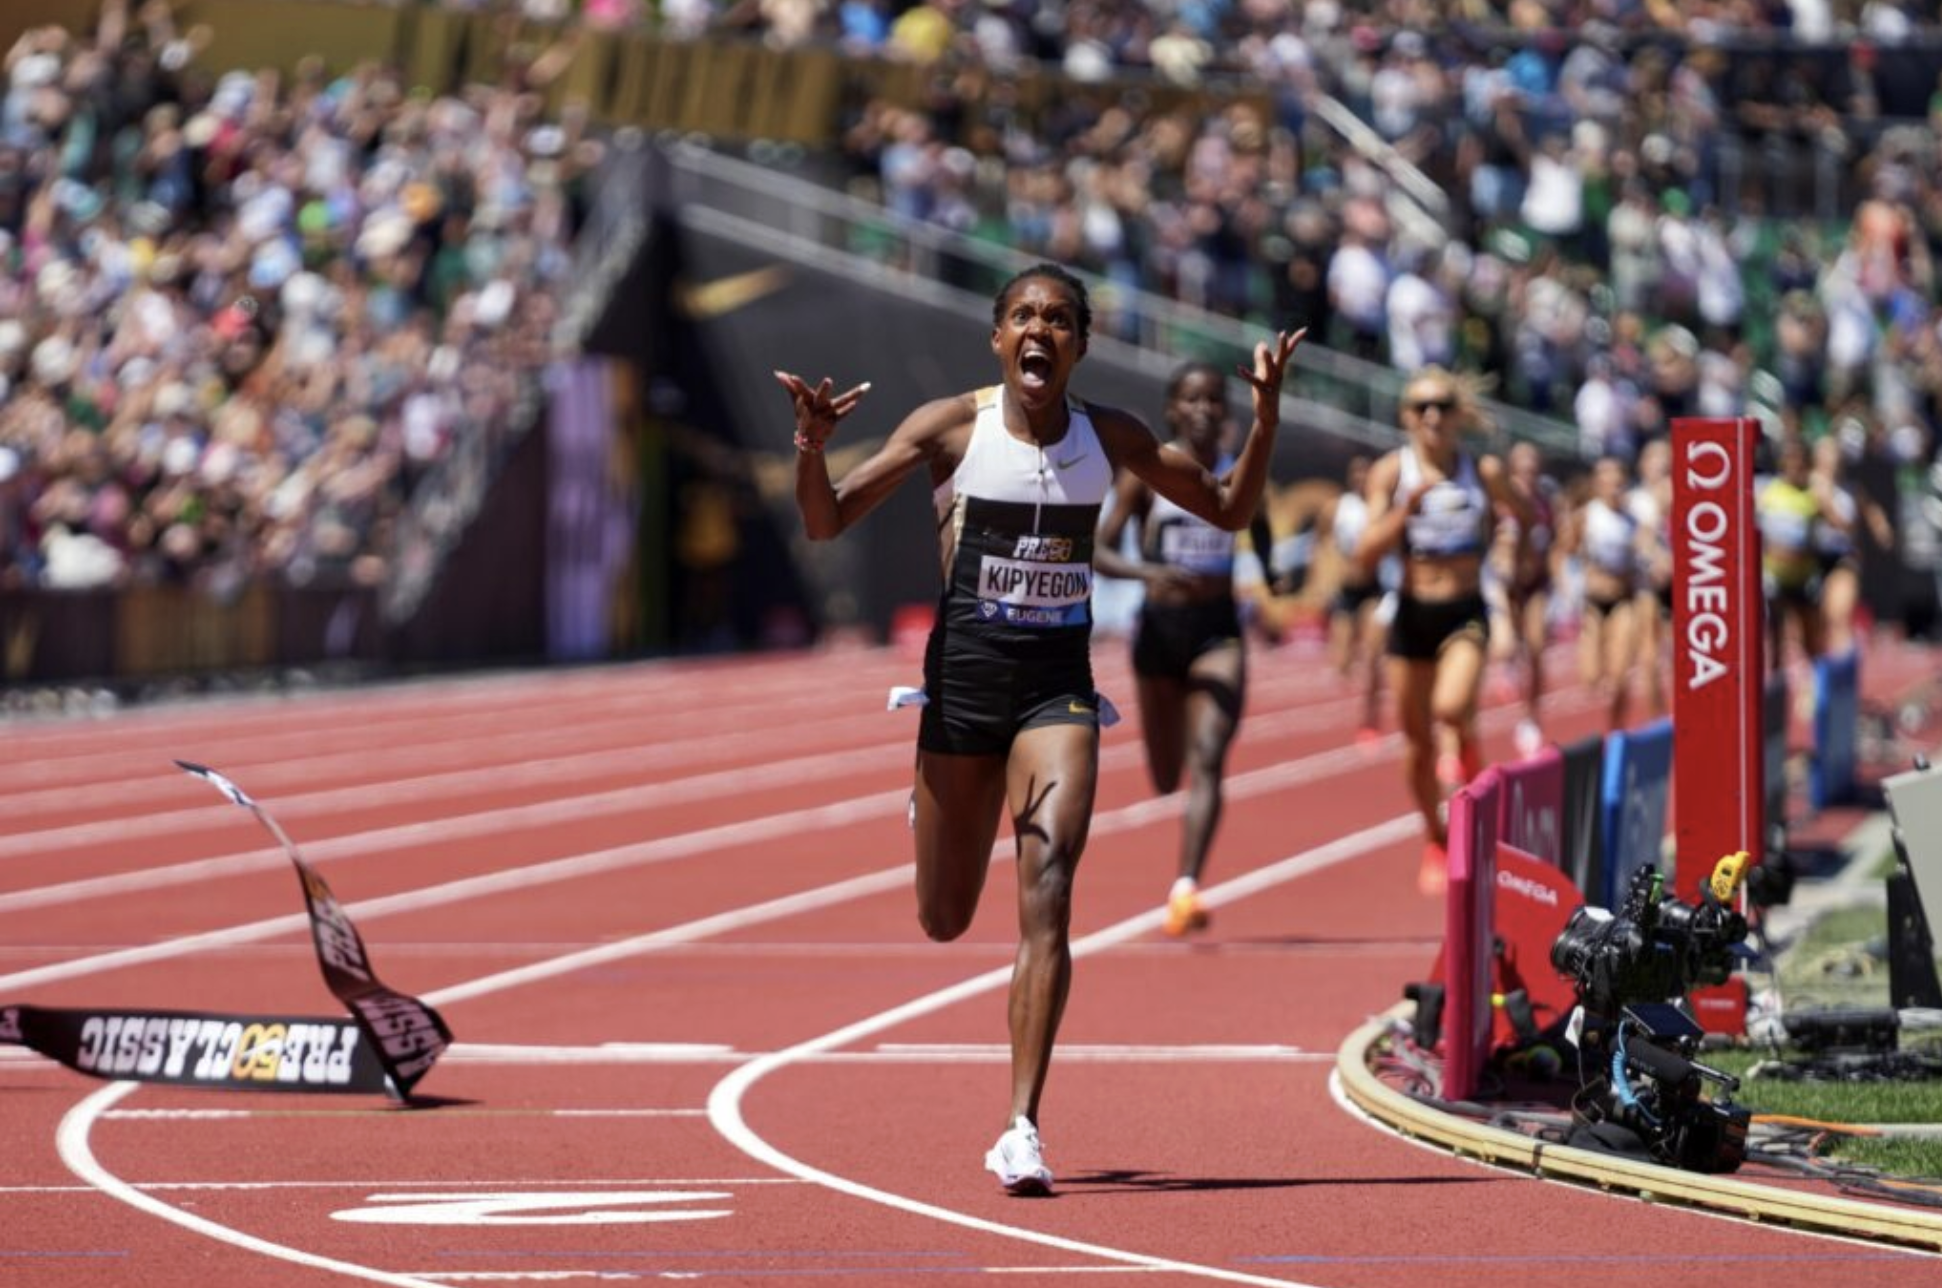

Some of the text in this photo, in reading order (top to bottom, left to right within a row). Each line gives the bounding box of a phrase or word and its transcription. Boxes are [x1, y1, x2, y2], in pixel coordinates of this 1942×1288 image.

[987, 565, 1088, 598] KIPYEGON
[1687, 501, 1729, 689] OMEGA
[1006, 608, 1064, 623] EUGENE
[1496, 870, 1558, 907] OMEGA
